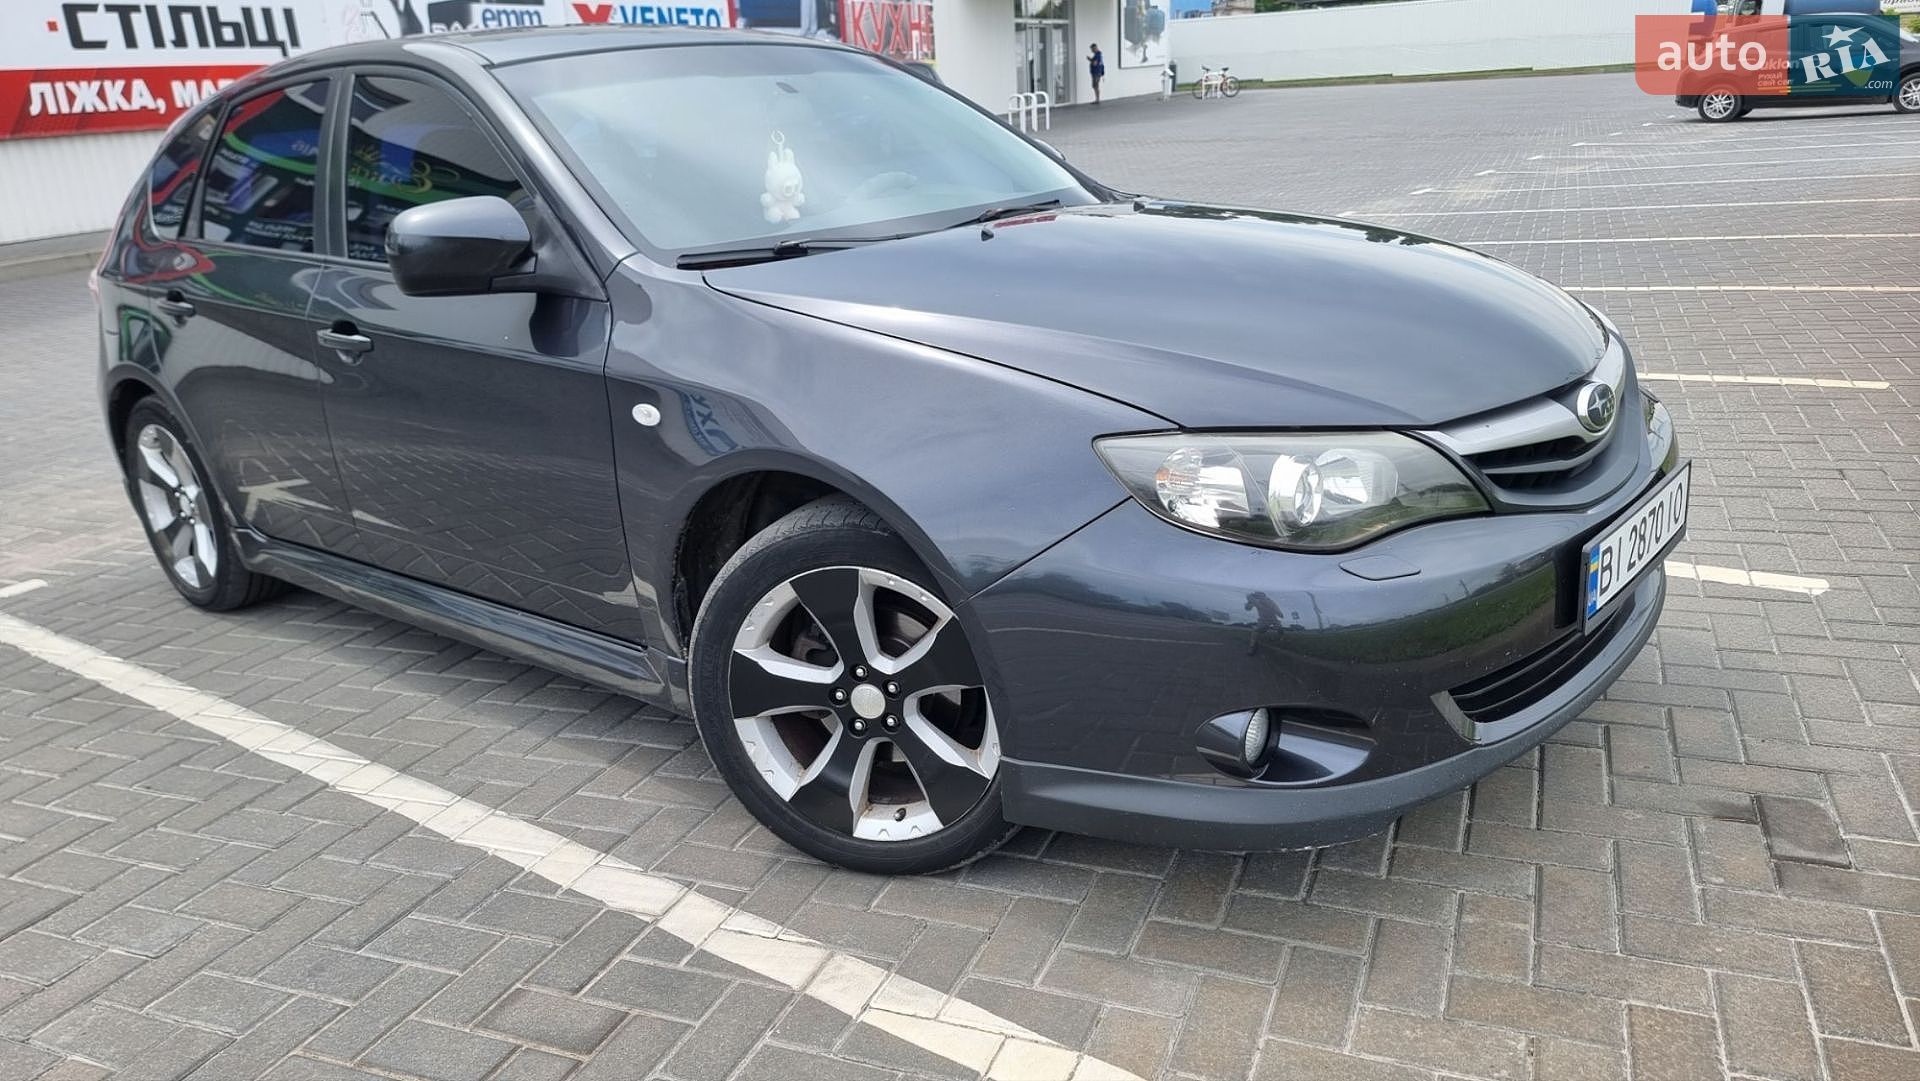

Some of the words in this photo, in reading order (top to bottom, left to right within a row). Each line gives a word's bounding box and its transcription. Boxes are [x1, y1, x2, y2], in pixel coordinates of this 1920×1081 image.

[62, 3, 300, 57] СТІЛЬЦІ
[619, 5, 722, 28] VENETO
[29, 78, 167, 117] ЛІЖКА,
[1600, 537, 1622, 597] BI
[1627, 501, 1664, 573] 2870
[1667, 482, 1683, 533] IO
